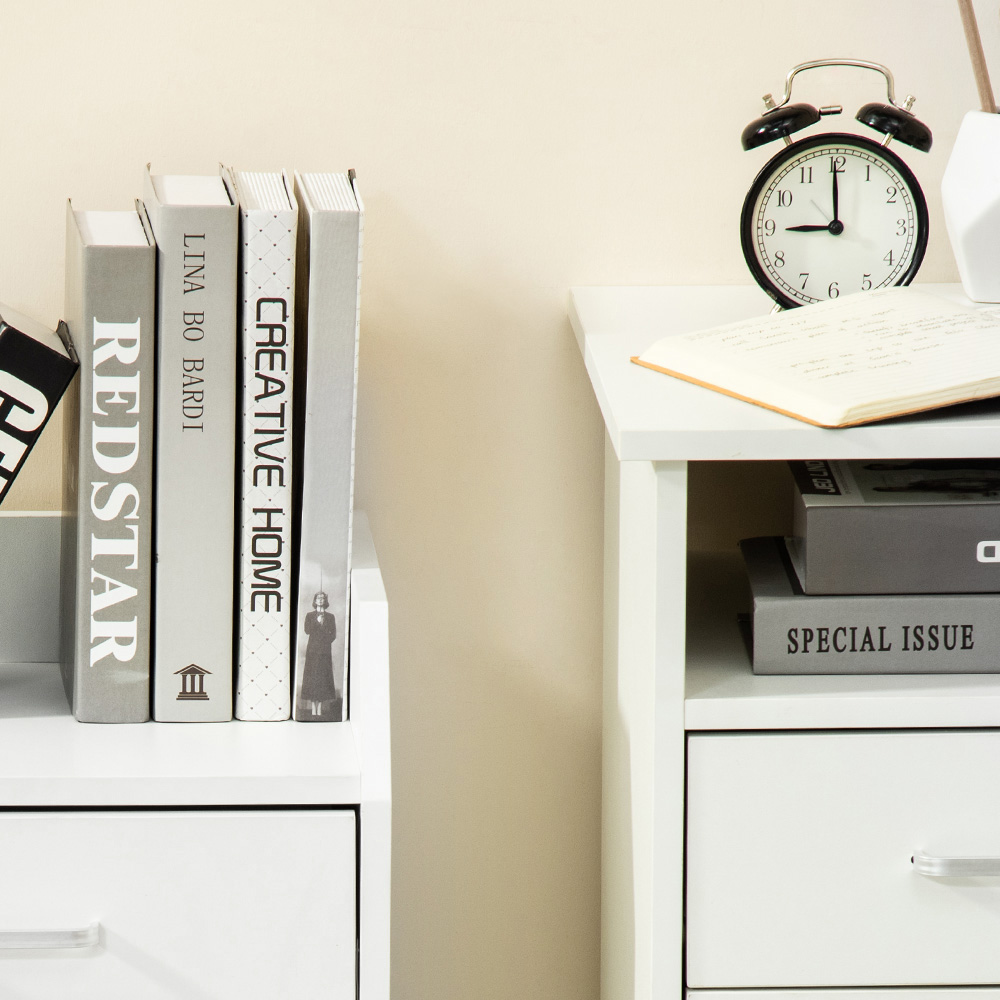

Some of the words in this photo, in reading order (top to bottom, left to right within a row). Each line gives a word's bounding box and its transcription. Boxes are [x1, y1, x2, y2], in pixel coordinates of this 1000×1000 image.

[828, 156, 847, 173] 12
[864, 164, 872, 182] 1
[799, 166, 814, 184] 11
[776, 189, 793, 207] 10
[886, 186, 898, 204] 2
[764, 219, 776, 237] 9
[896, 218, 907, 236] 3
[183, 232, 206, 295] LINA
[774, 251, 786, 268] 8
[883, 249, 896, 266] 4
[799, 272, 810, 290] 7
[828, 282, 840, 298] 6
[862, 273, 872, 291] 5
[183, 310, 205, 342] BO
[182, 357, 205, 433] BARDI
[252, 297, 287, 487] CREATIVE
[89, 316, 141, 668] REDSTAR
[250, 508, 283, 613] HOME
[787, 626, 892, 655] SPECIAL
[901, 624, 975, 652] ISSUE
